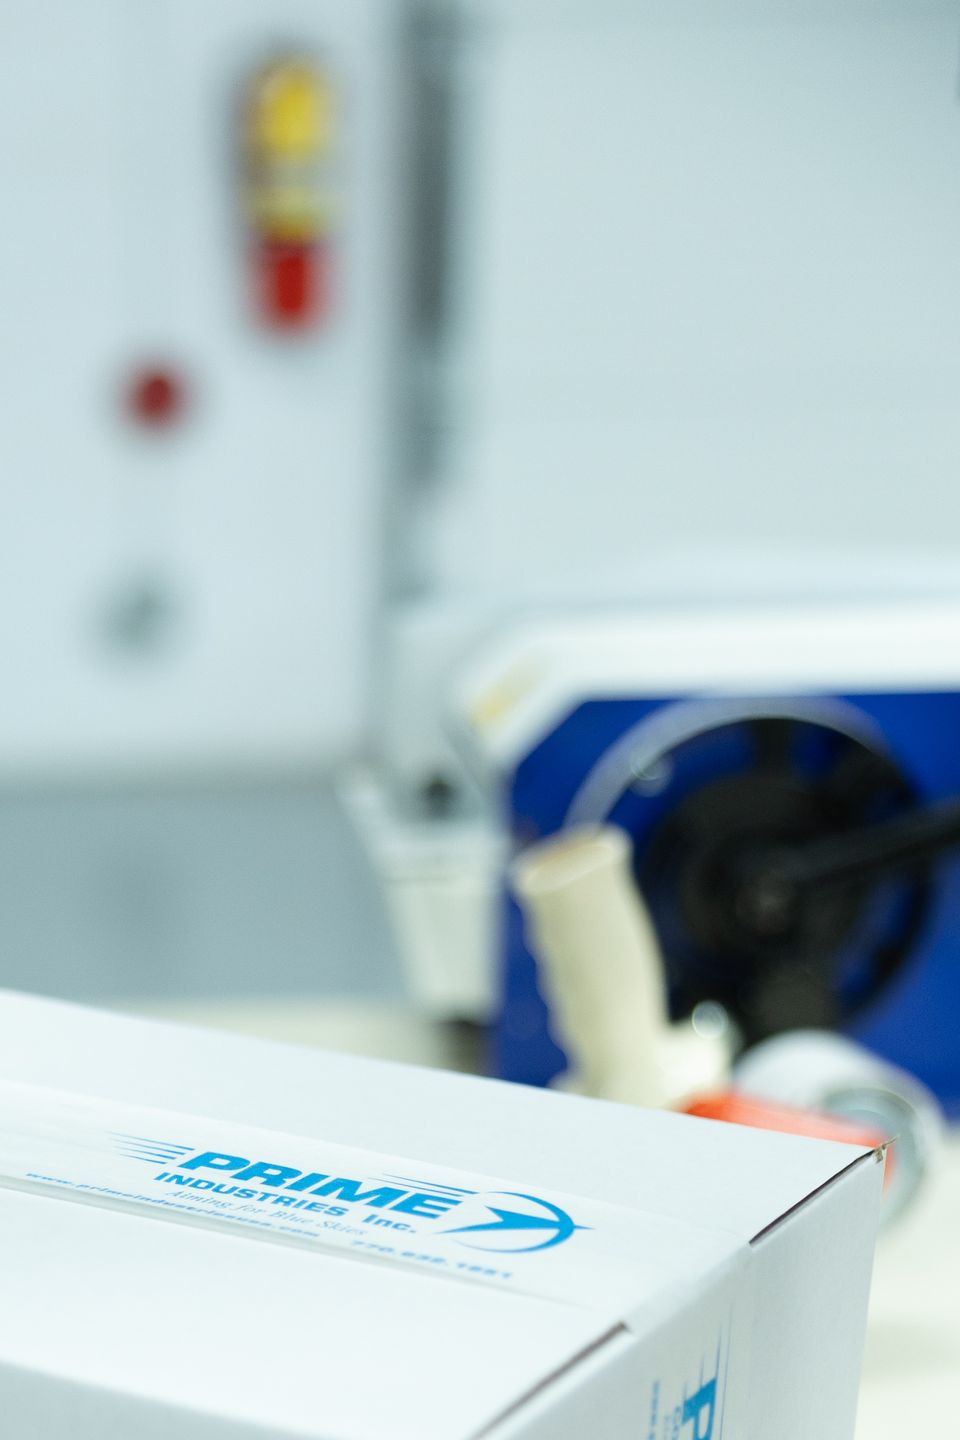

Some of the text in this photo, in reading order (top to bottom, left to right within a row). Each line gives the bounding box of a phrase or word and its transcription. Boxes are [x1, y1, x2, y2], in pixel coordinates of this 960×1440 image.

[153, 1170, 417, 1235] INDUSTRIES Inc.
[176, 1150, 462, 1220] PRIME
